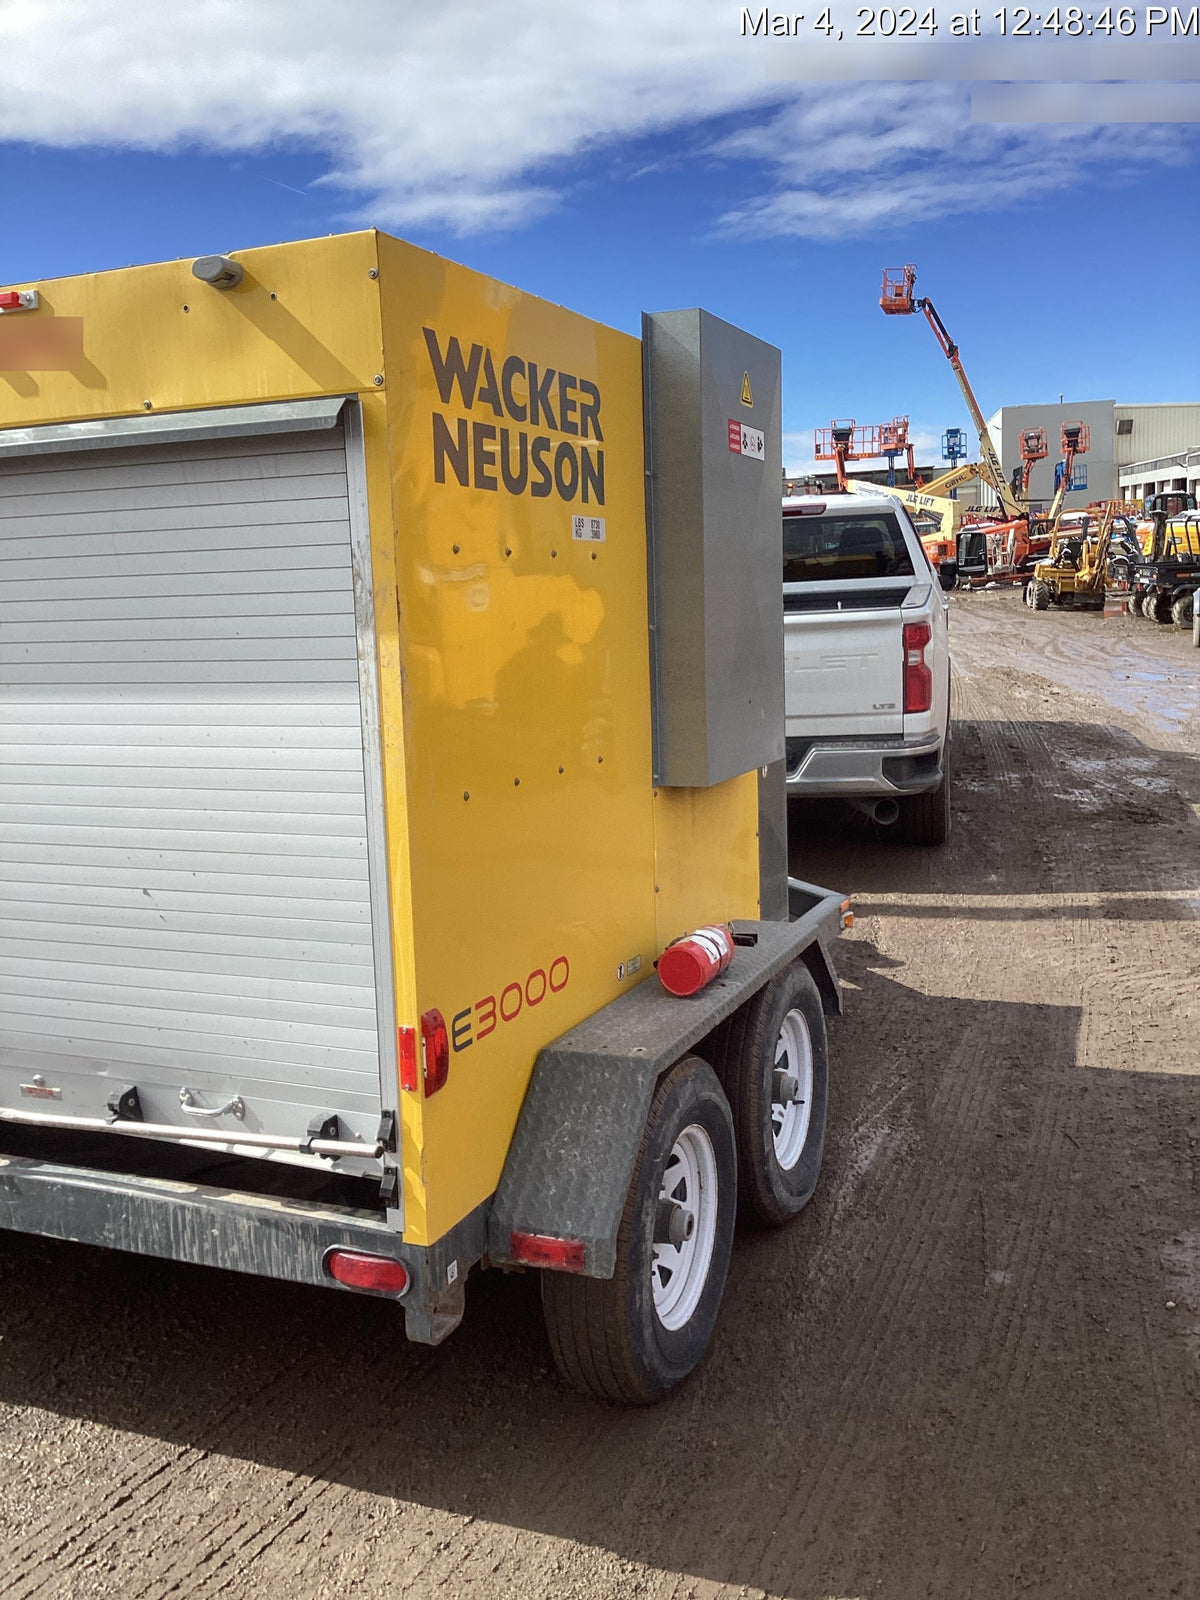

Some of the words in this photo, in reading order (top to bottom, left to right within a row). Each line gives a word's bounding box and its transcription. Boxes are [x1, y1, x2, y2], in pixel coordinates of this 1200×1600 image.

[422, 326, 604, 442] WACKER
[432, 412, 605, 506] NEUSON
[920, 496, 935, 506] LIFT
[945, 475, 966, 488] GEHL
[452, 956, 569, 1053] E3000
